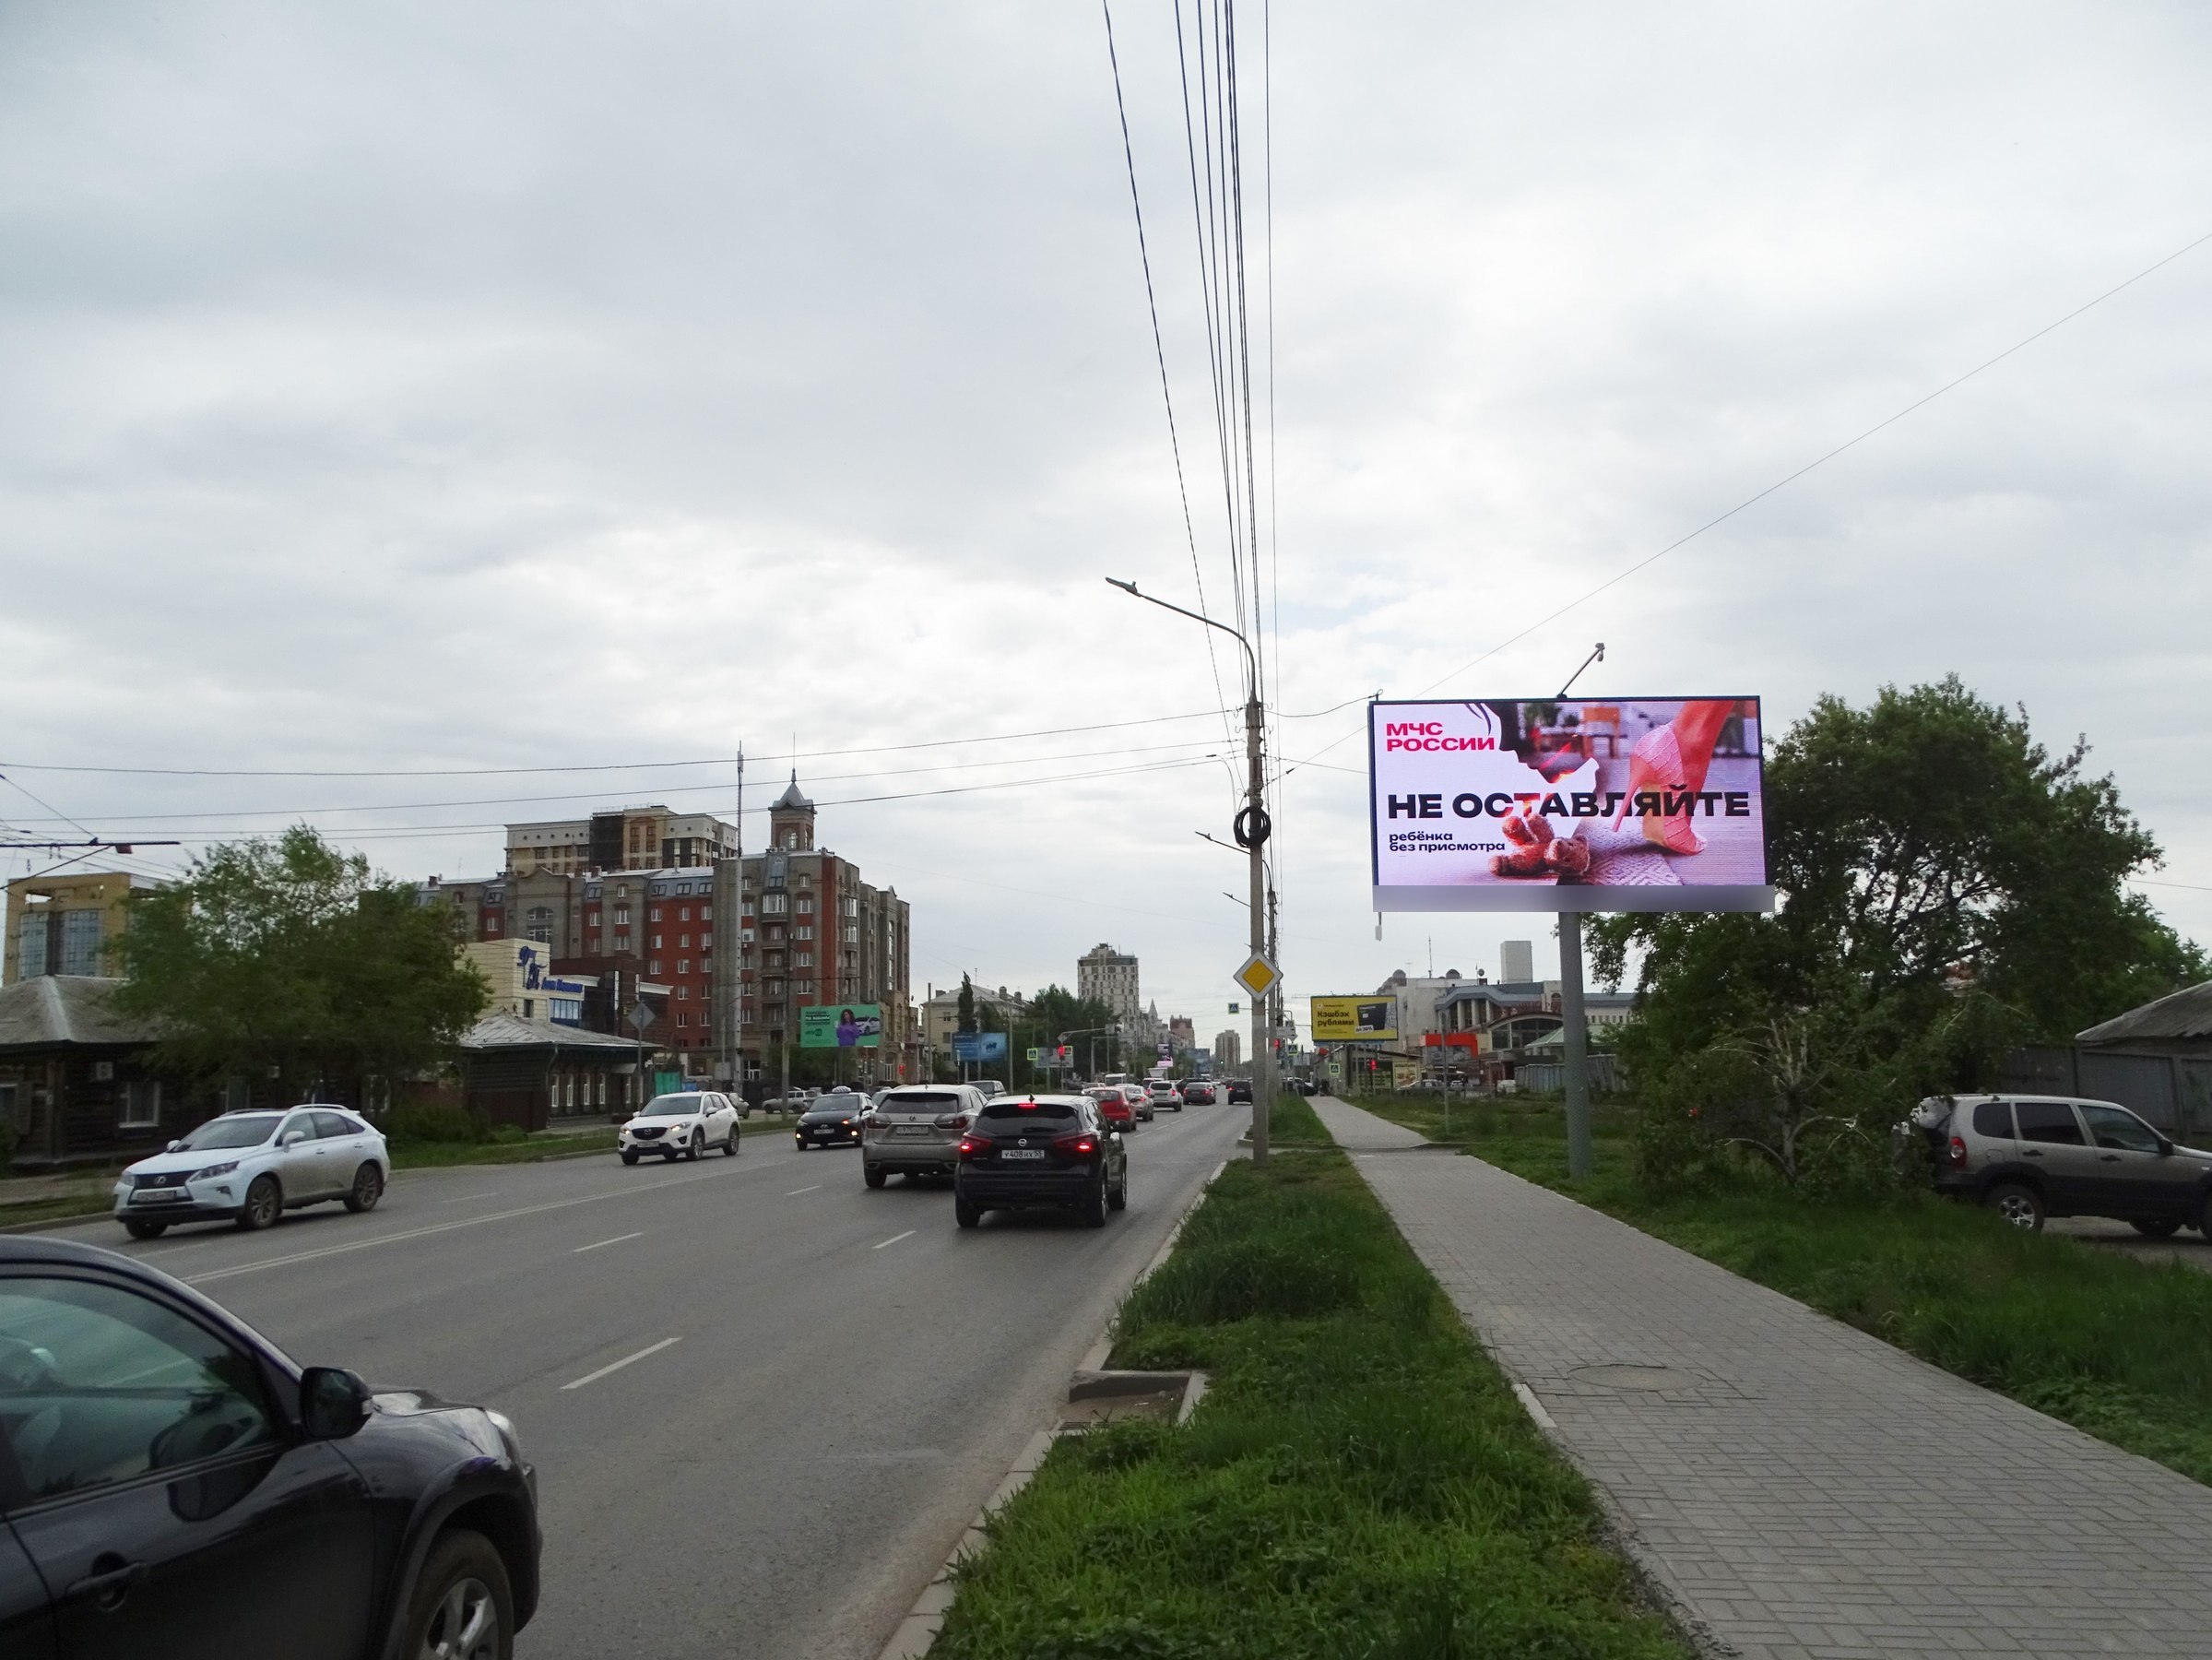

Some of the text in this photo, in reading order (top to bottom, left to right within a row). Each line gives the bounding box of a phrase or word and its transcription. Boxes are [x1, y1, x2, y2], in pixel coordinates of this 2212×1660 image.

[1386, 722, 1444, 736] МЧС
[1386, 737, 1496, 752] РОССИИ
[1388, 784, 1751, 819] НЕ ОСТАВЛЯЙТЕ
[1389, 831, 1453, 843] ребёнка
[1389, 842, 1506, 853] без присмотра
[1317, 1010, 1350, 1018] Кэшбэк
[1317, 1018, 1354, 1027] рублями
